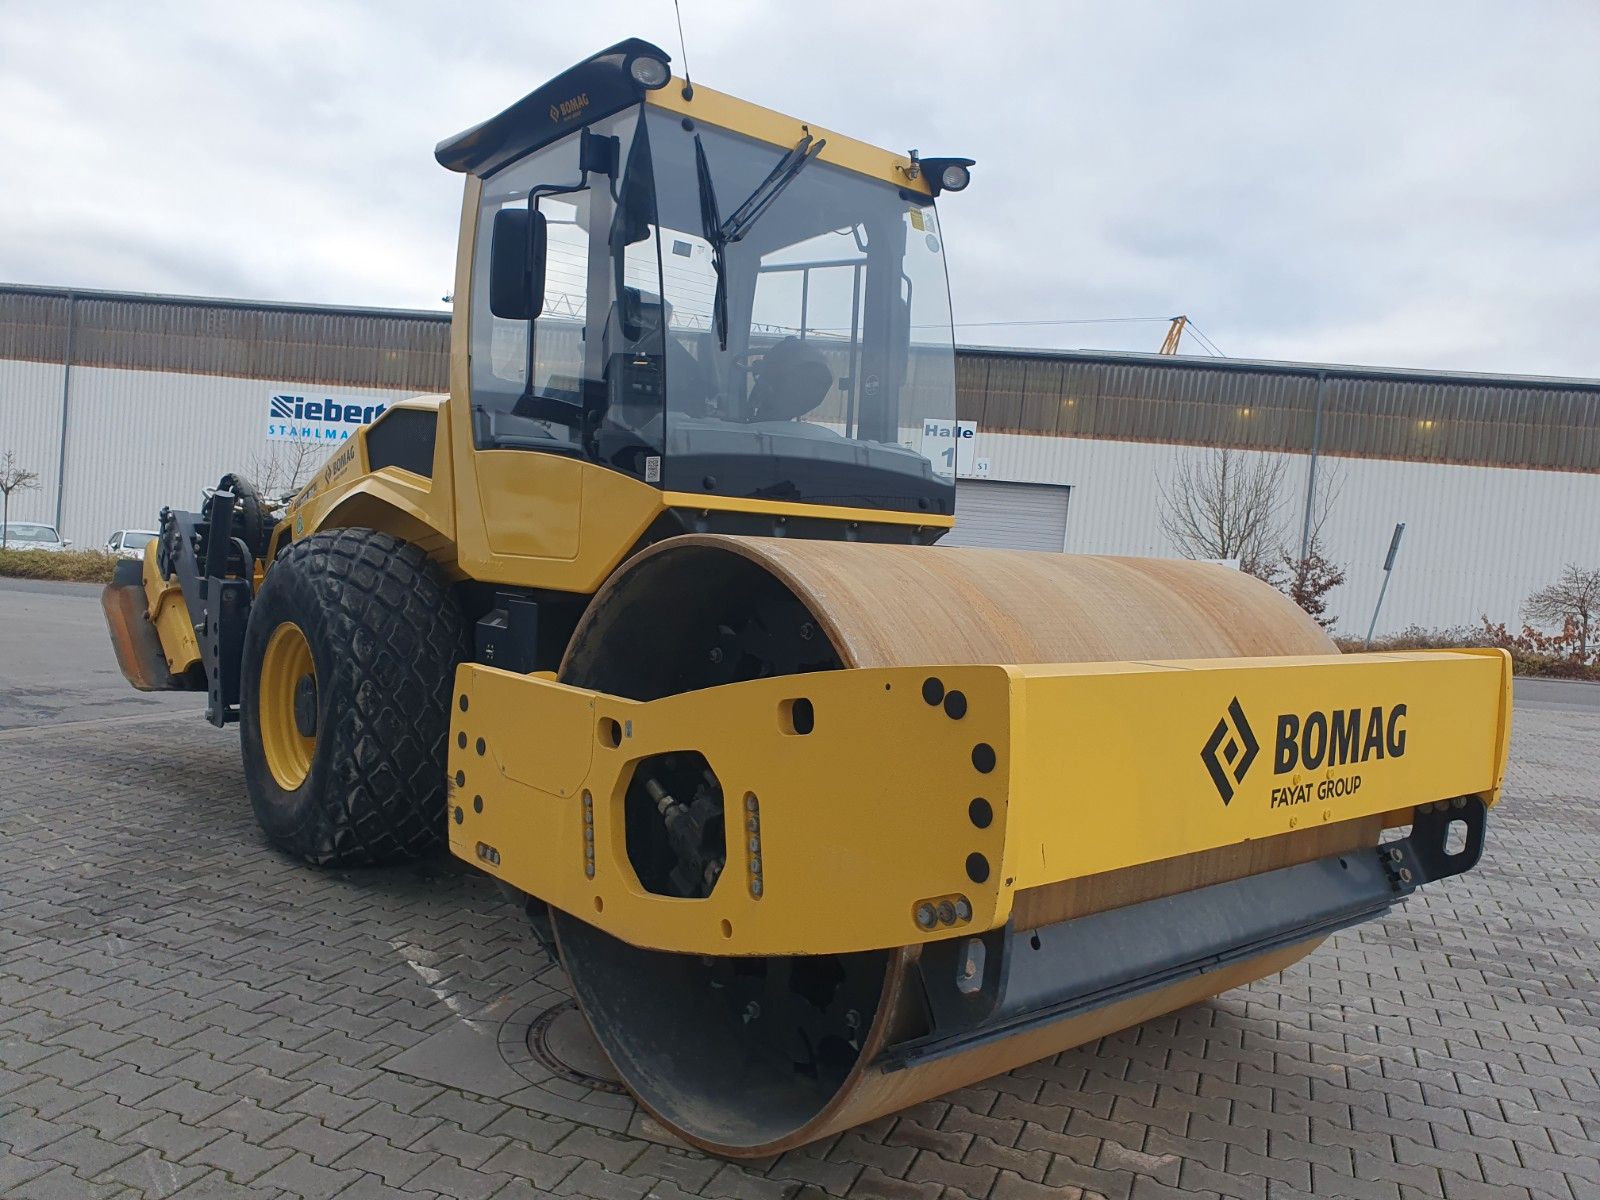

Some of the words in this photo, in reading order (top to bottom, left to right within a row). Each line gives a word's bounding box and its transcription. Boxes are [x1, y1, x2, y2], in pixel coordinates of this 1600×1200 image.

[560, 93, 590, 116] BOMAG
[268, 424, 349, 440] STAHLMA
[925, 424, 974, 439] Halle
[332, 445, 355, 476] BOMAG
[941, 447, 955, 468] 1
[1273, 703, 1408, 775] BOMAG
[1270, 783, 1314, 809] FAYAT
[1317, 775, 1362, 801] GROUP
